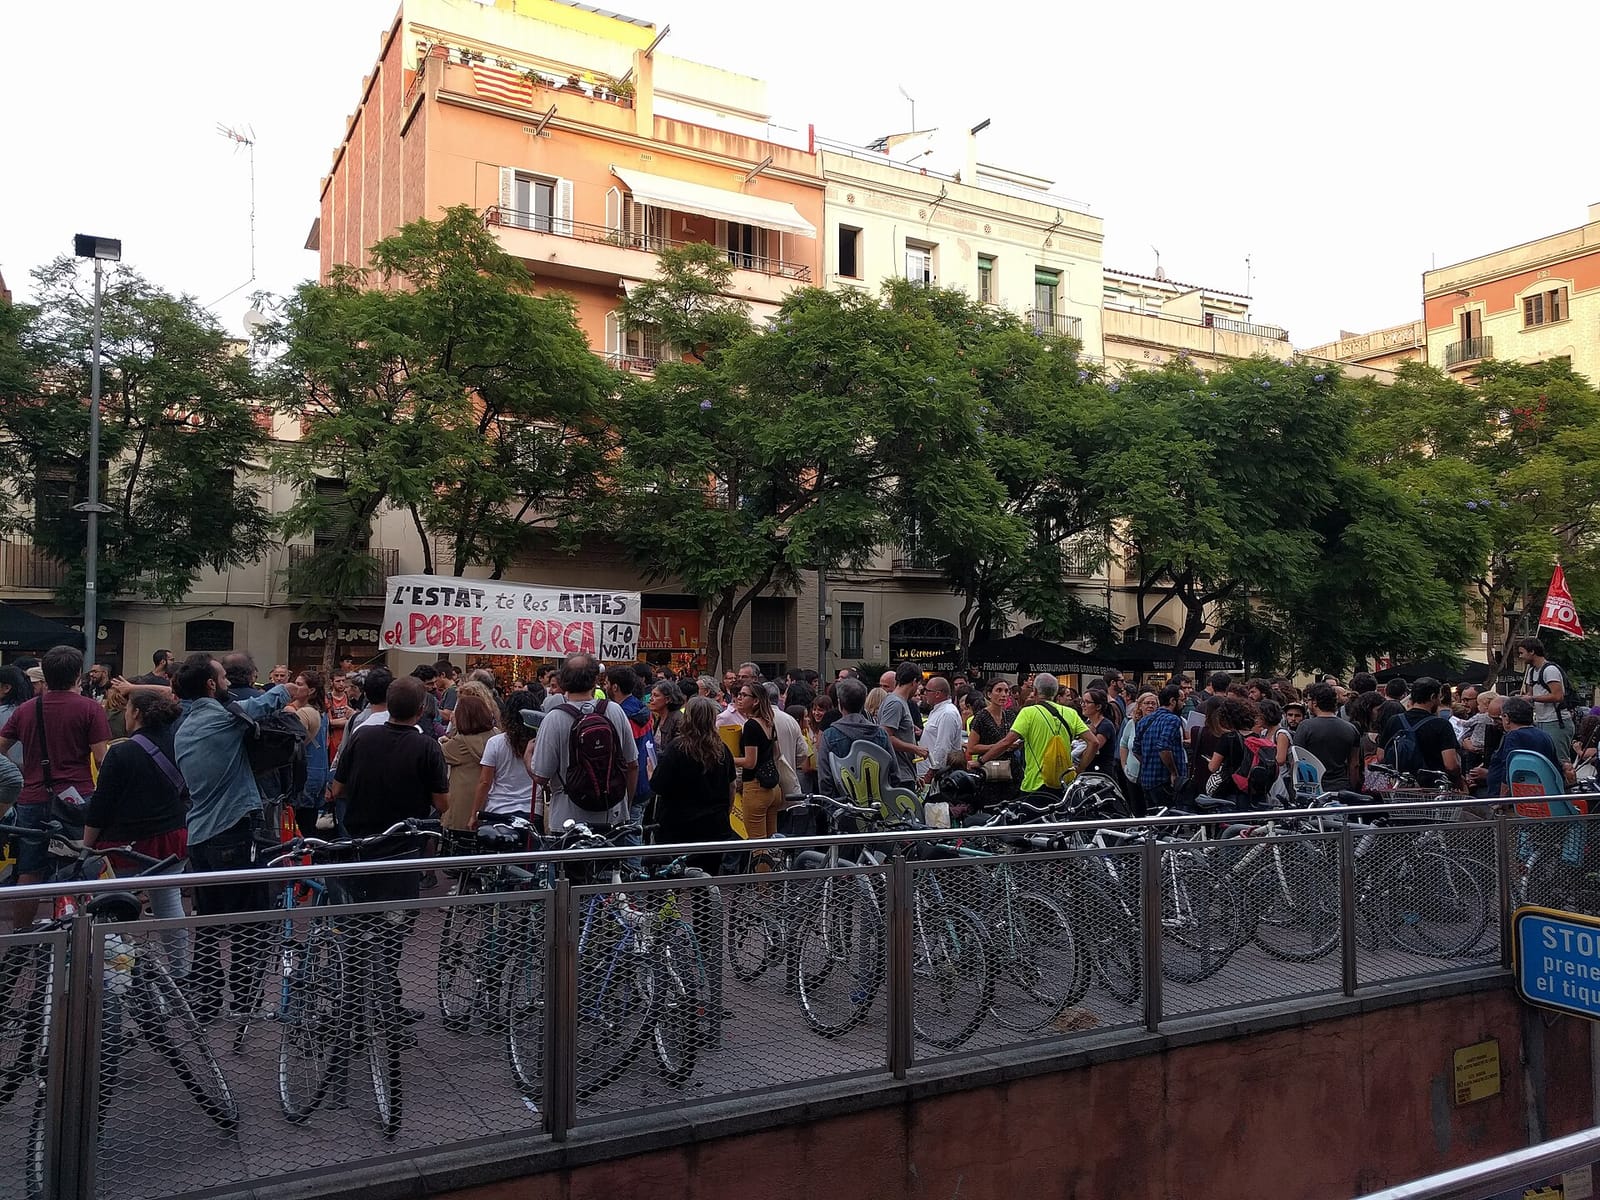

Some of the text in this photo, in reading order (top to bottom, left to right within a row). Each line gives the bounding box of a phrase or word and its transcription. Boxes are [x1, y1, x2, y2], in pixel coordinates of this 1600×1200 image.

[392, 585, 627, 616] L'ESTAT, té les ARMES
[297, 627, 379, 643] CAERES
[384, 612, 596, 655] el POBLE, la FORÇA
[607, 623, 633, 644] 1-0
[640, 616, 672, 641] NI
[602, 643, 636, 661] VOTA!
[936, 662, 955, 671] TAPES
[983, 662, 1019, 671] FRANKFURT
[1543, 956, 1600, 981] prene
[1536, 976, 1600, 1006] el tiqu
